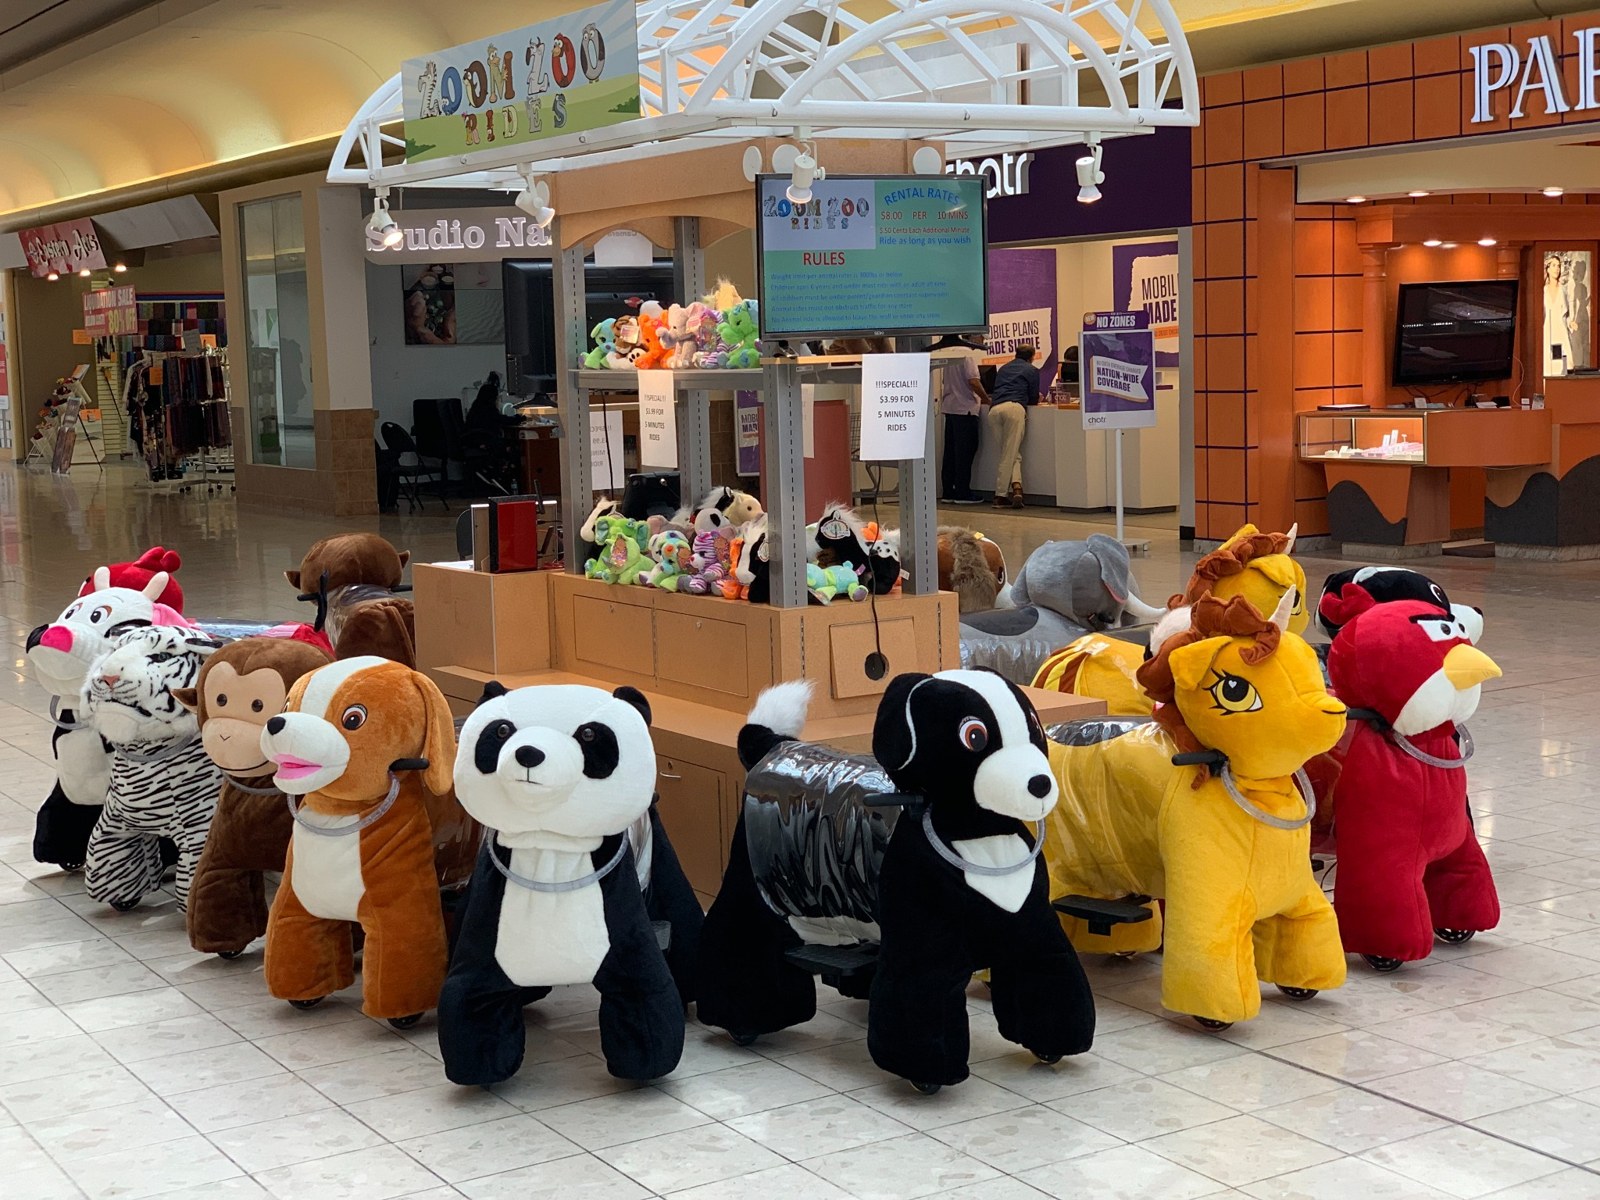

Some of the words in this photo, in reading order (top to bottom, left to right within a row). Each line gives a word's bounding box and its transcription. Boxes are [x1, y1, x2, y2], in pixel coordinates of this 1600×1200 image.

[417, 43, 515, 119] ZOOM
[526, 23, 606, 96] ZOO
[462, 93, 567, 145] RIDES
[946, 153, 1034, 199] atr
[884, 187, 925, 206] RENTAL
[927, 187, 961, 206] RATES
[764, 195, 821, 218] ZOOM
[827, 196, 870, 218] ZOO
[791, 217, 849, 230] RIDES
[880, 211, 903, 220] $8.00
[912, 211, 927, 220] PER
[937, 211, 946, 220] 10
[948, 211, 969, 220] MINS
[366, 219, 485, 252] Sudio
[951, 226, 970, 234] Minute
[72, 229, 99, 261] Arts
[879, 236, 896, 245] Ride
[908, 236, 926, 247] long
[937, 238, 952, 246] you
[953, 236, 971, 244] wish
[803, 252, 845, 266] RULES
[1142, 273, 1179, 300] MOBIL
[118, 287, 135, 306] SALE
[1012, 320, 1039, 337] PLANS
[1096, 316, 1108, 328] NO
[1109, 315, 1136, 328] ZONES
[987, 340, 1006, 356] ADE
[1097, 367, 1139, 384] NATION-WIDE
[875, 380, 918, 389] !!!SPECIAL!!!
[1097, 376, 1131, 392] COVERAGE
[879, 396, 899, 404] $3.99
[648, 421, 665, 429] MINUTES
